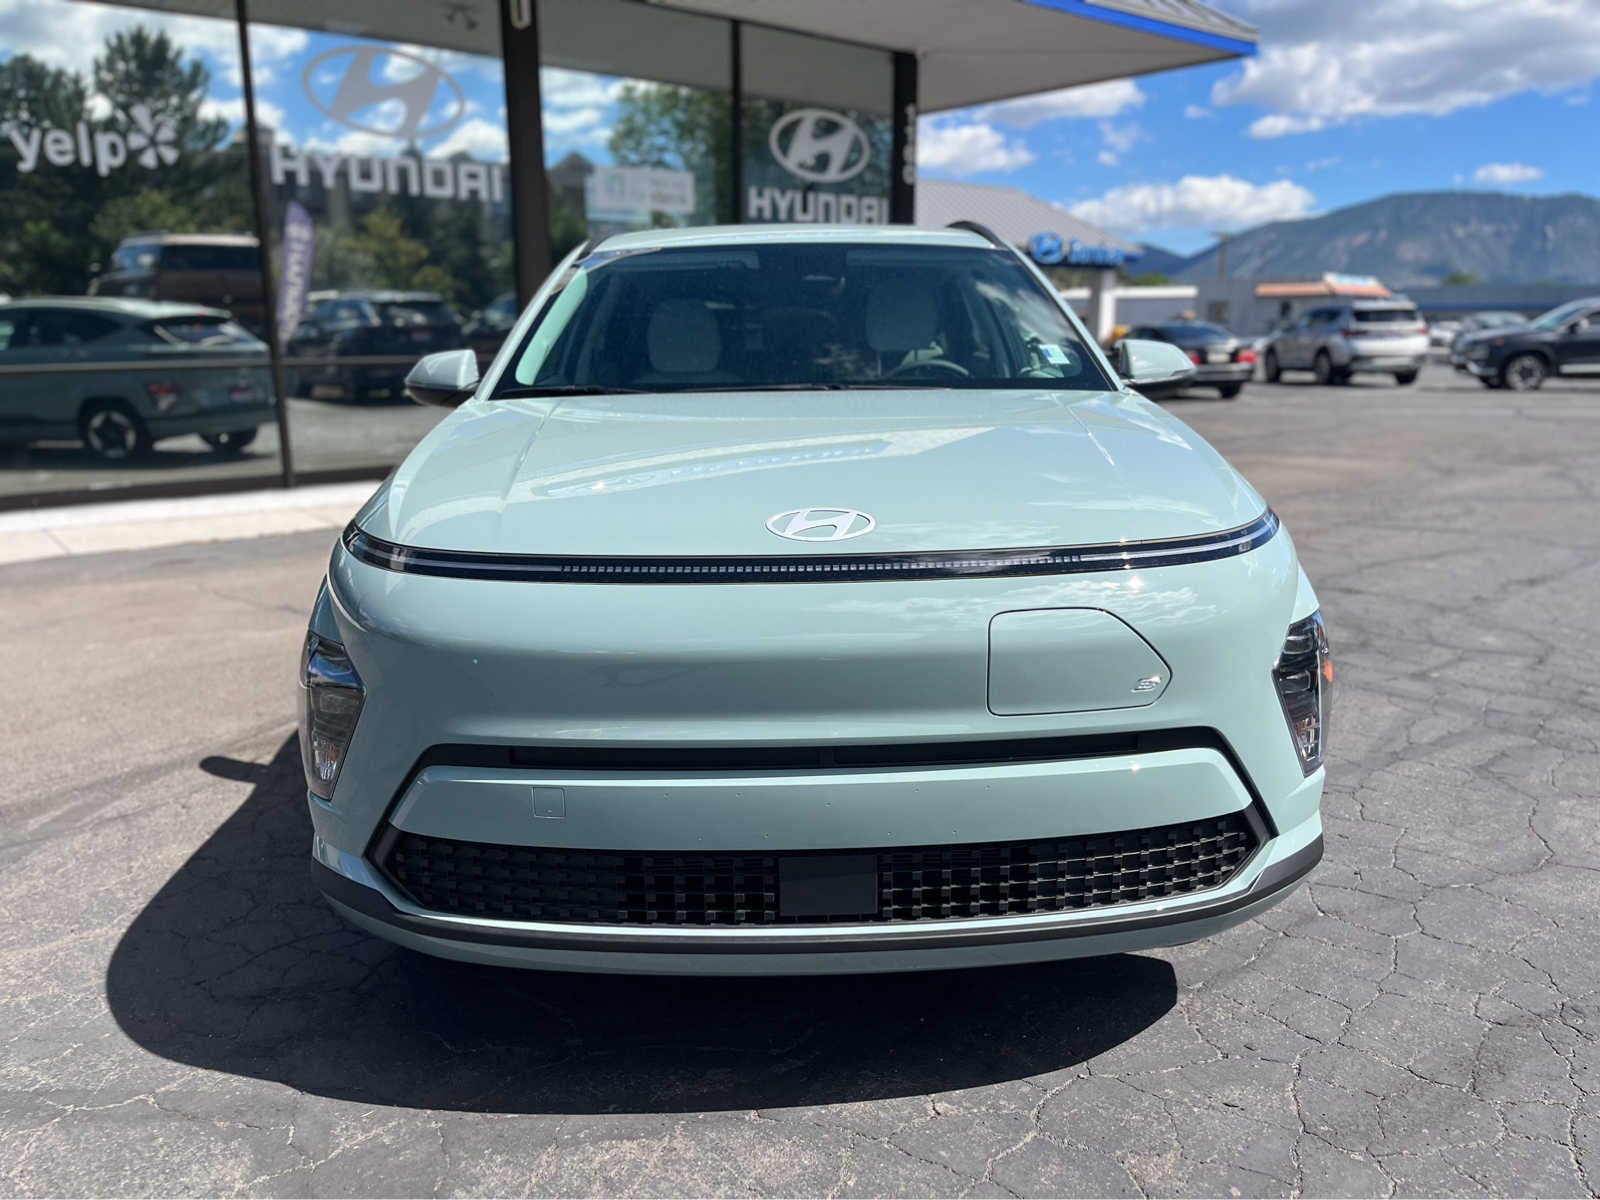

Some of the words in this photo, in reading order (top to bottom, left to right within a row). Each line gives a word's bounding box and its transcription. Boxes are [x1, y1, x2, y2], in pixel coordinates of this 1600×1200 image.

[8, 120, 127, 177] yelp
[271, 143, 504, 203] HYUNDAI
[747, 184, 890, 225] HYUNDAI
